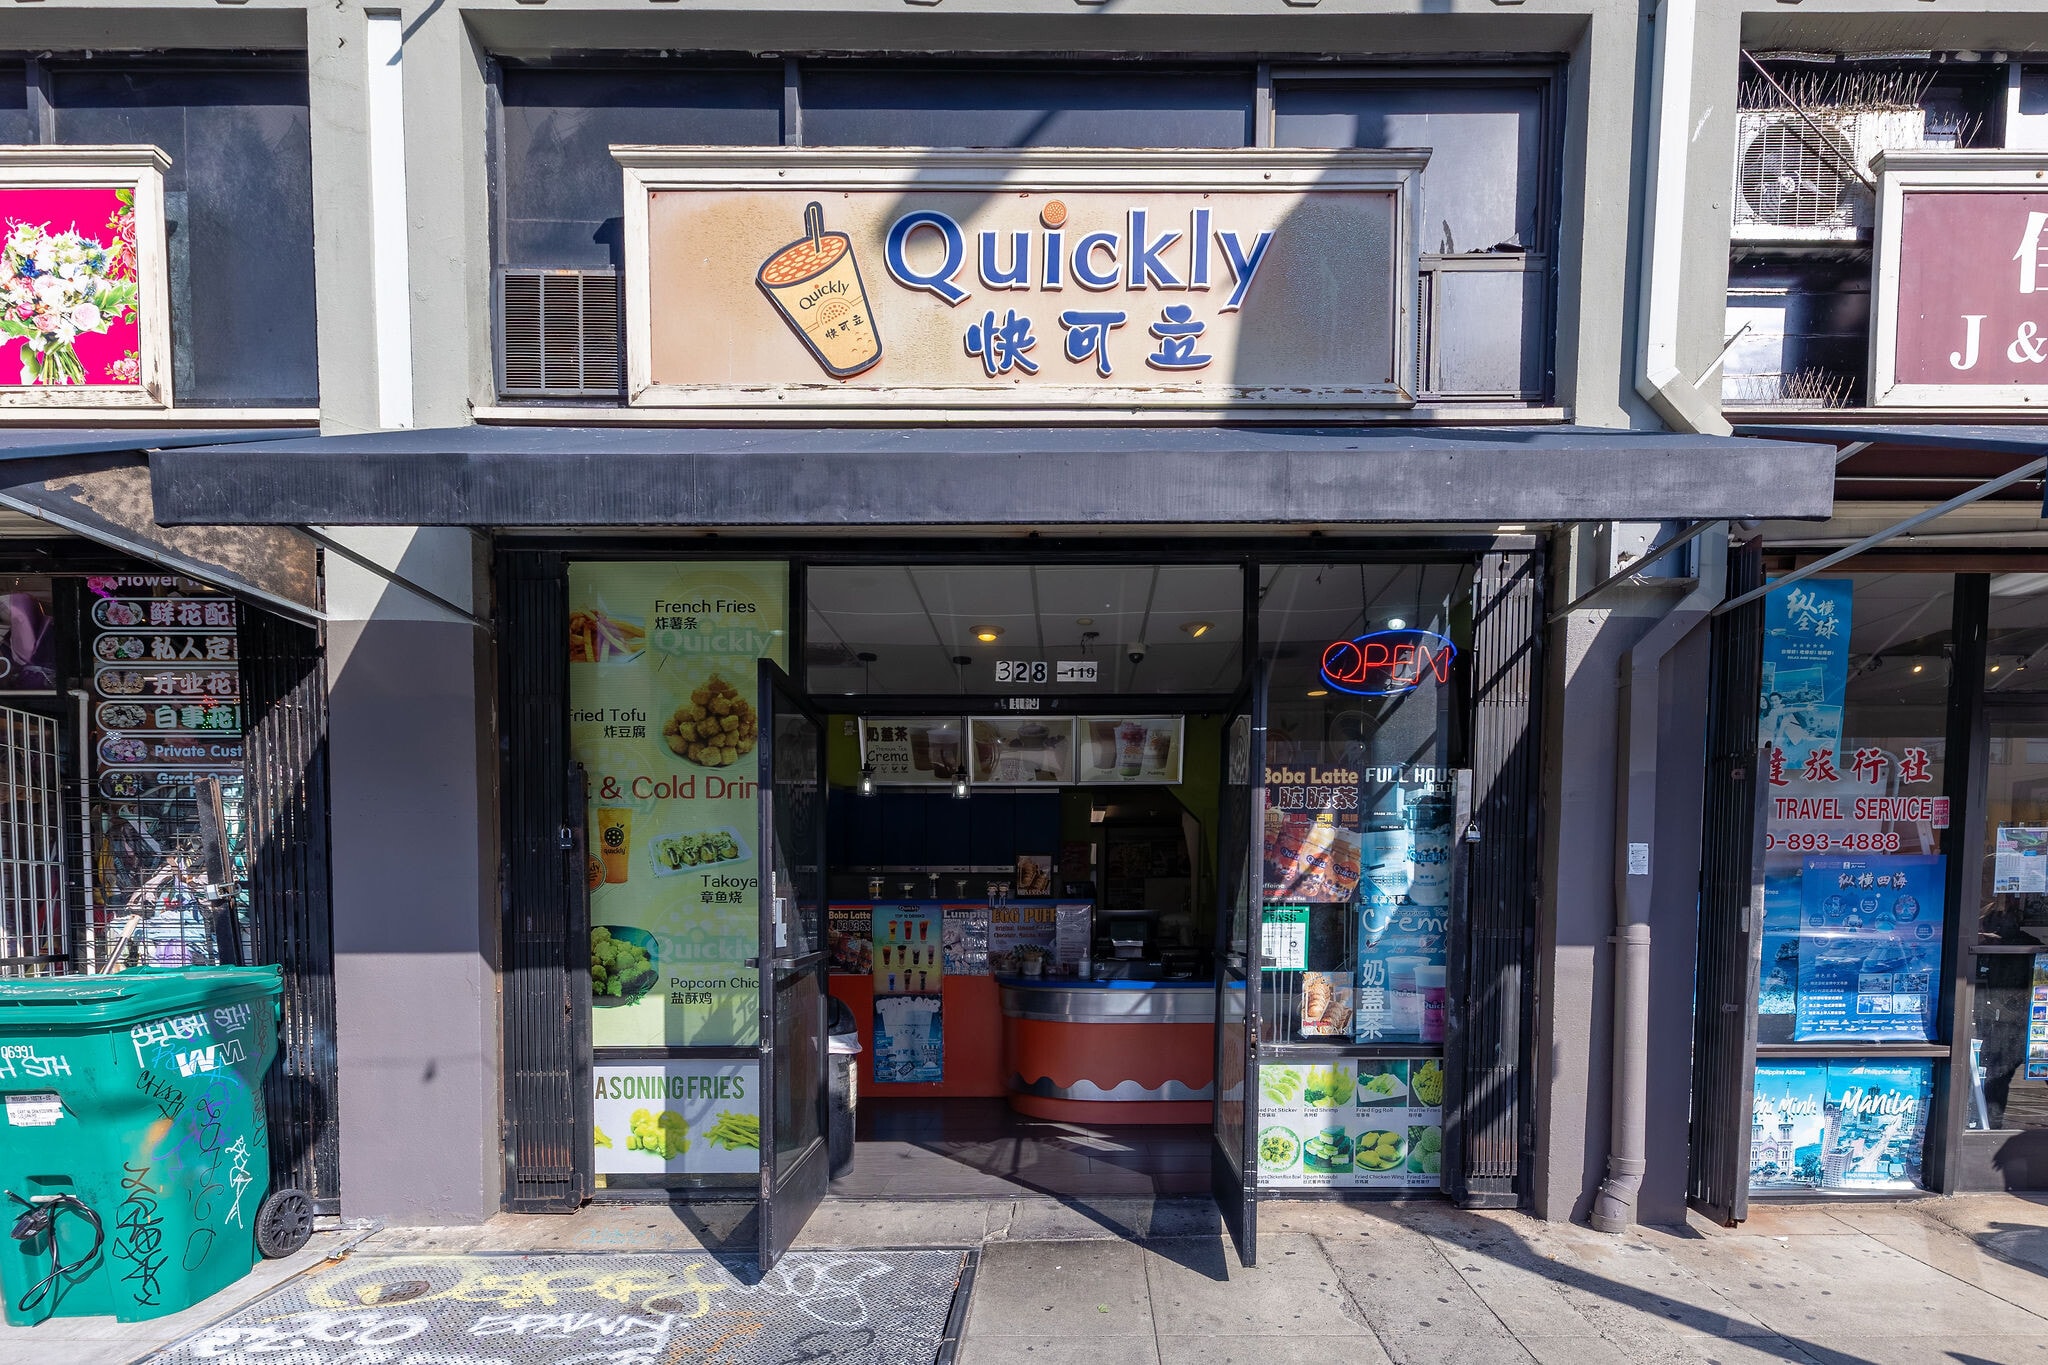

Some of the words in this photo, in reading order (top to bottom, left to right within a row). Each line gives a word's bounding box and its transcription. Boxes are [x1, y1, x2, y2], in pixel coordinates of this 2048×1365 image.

[884, 199, 1275, 313] Quickly
[799, 280, 849, 310] Quickly
[825, 314, 864, 339] 快可立
[964, 304, 1214, 376] 快可立
[1950, 315, 1987, 370] J
[2007, 321, 2047, 363] &
[150, 602, 236, 626] 鲜花配
[655, 600, 711, 613] French
[716, 600, 756, 613] Fries
[655, 617, 698, 631] 炸薯条
[151, 636, 237, 660] 私人定
[997, 661, 1046, 681] 328
[1057, 667, 1096, 679] -119
[1323, 641, 1449, 684] OPEN
[153, 671, 240, 694] 开业花
[155, 704, 241, 728] 白事花
[609, 709, 646, 722] Tofu
[603, 725, 646, 739] 炸豆腐
[155, 744, 206, 757] Private
[866, 750, 909, 763] Crema
[1265, 767, 1306, 785] Boba
[1310, 767, 1359, 785] Latte
[1365, 767, 1409, 783] FULL
[600, 776, 623, 800] &
[632, 774, 695, 800] Cold
[1775, 798, 1844, 820] TRAVEL
[1854, 798, 1931, 821] SERVICE
[700, 891, 743, 904] 章鱼烧
[828, 911, 849, 920] Boba
[850, 911, 871, 920] Latte
[991, 907, 1019, 923] EGG
[670, 977, 726, 991] Popcorn
[670, 992, 713, 1005] 盐酥鸡
[1757, 1069, 1784, 1077] Philippine
[1863, 1068, 1891, 1076] Philippine
[595, 1076, 683, 1100] ASONING
[688, 1076, 745, 1100] FRIES
[1778, 1092, 1817, 1116] Minh
[1840, 1087, 1915, 1117] Manila
